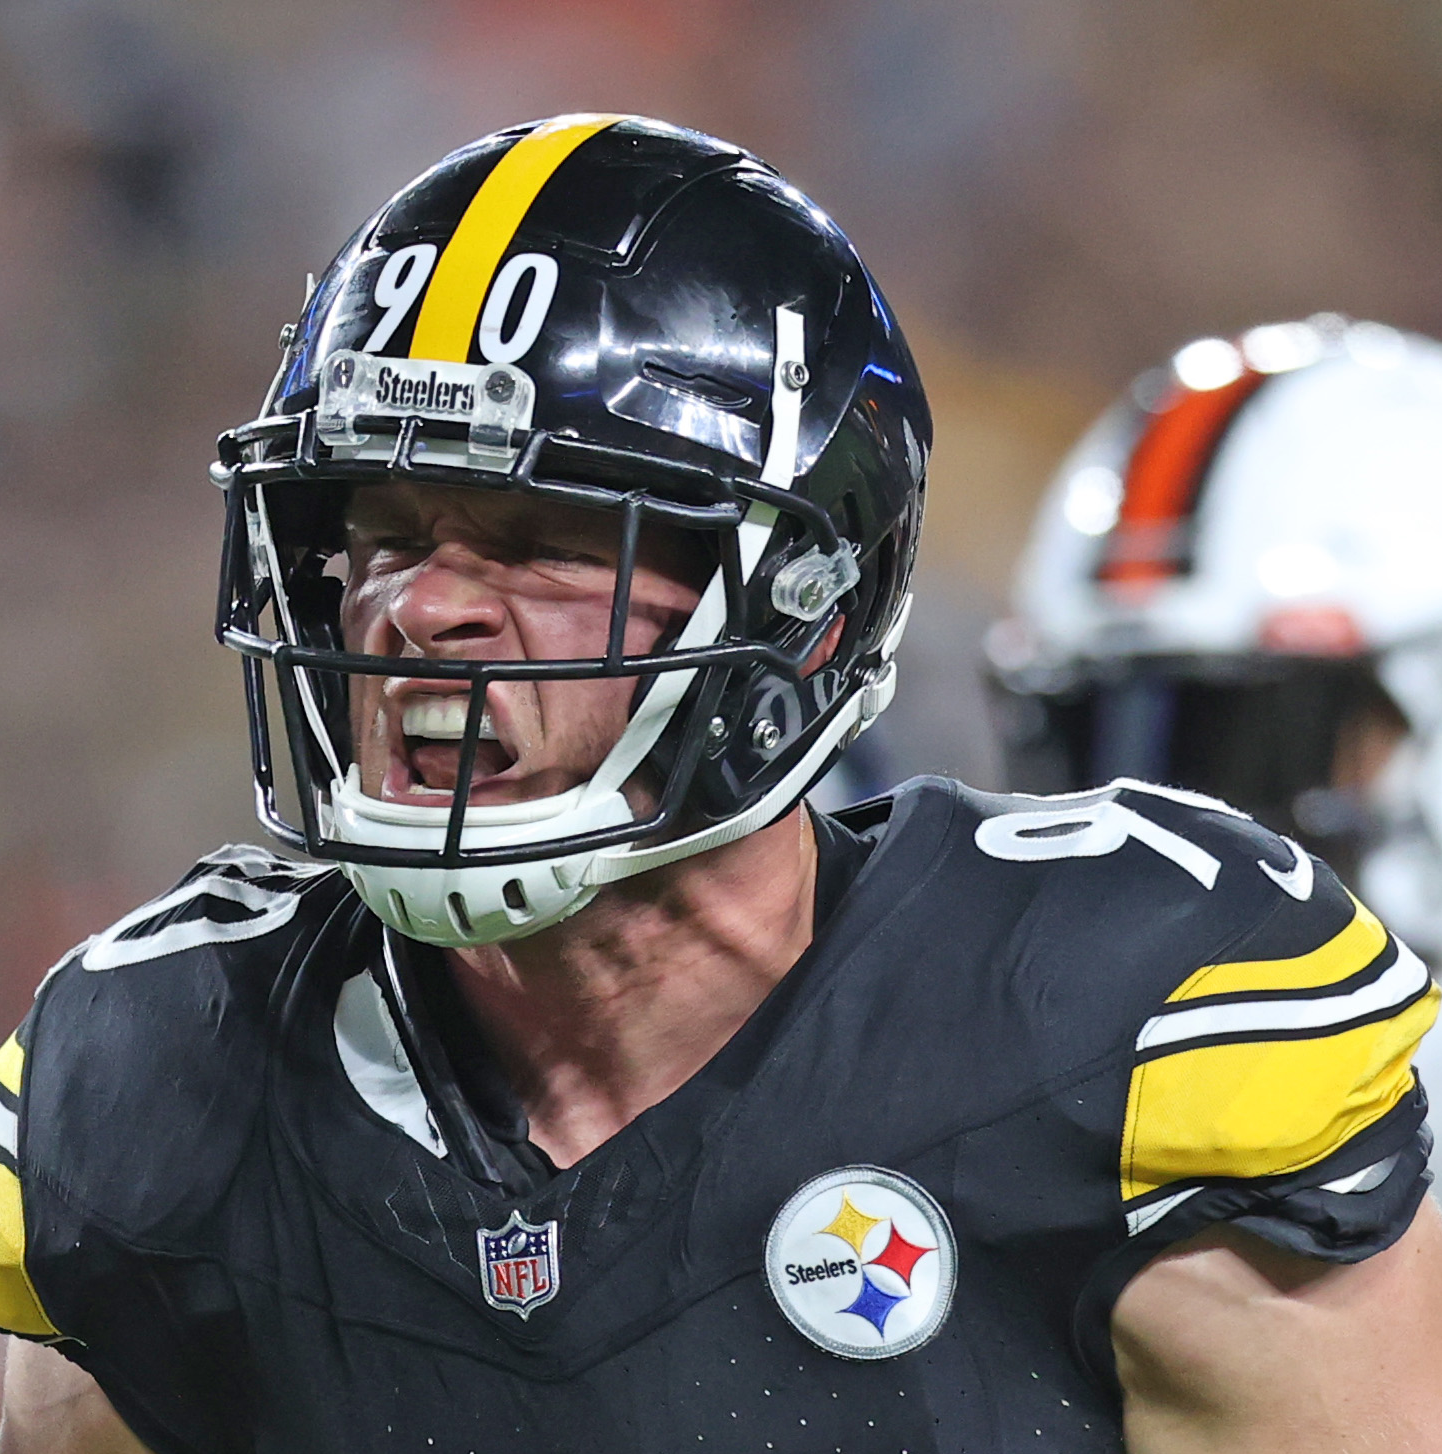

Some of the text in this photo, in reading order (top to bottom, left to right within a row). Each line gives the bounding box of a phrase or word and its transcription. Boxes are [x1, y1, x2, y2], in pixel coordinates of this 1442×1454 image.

[362, 243, 559, 364] 90
[376, 366, 475, 411] Steelers
[492, 1259, 548, 1299] NFL
[784, 1258, 858, 1286] Steelers
